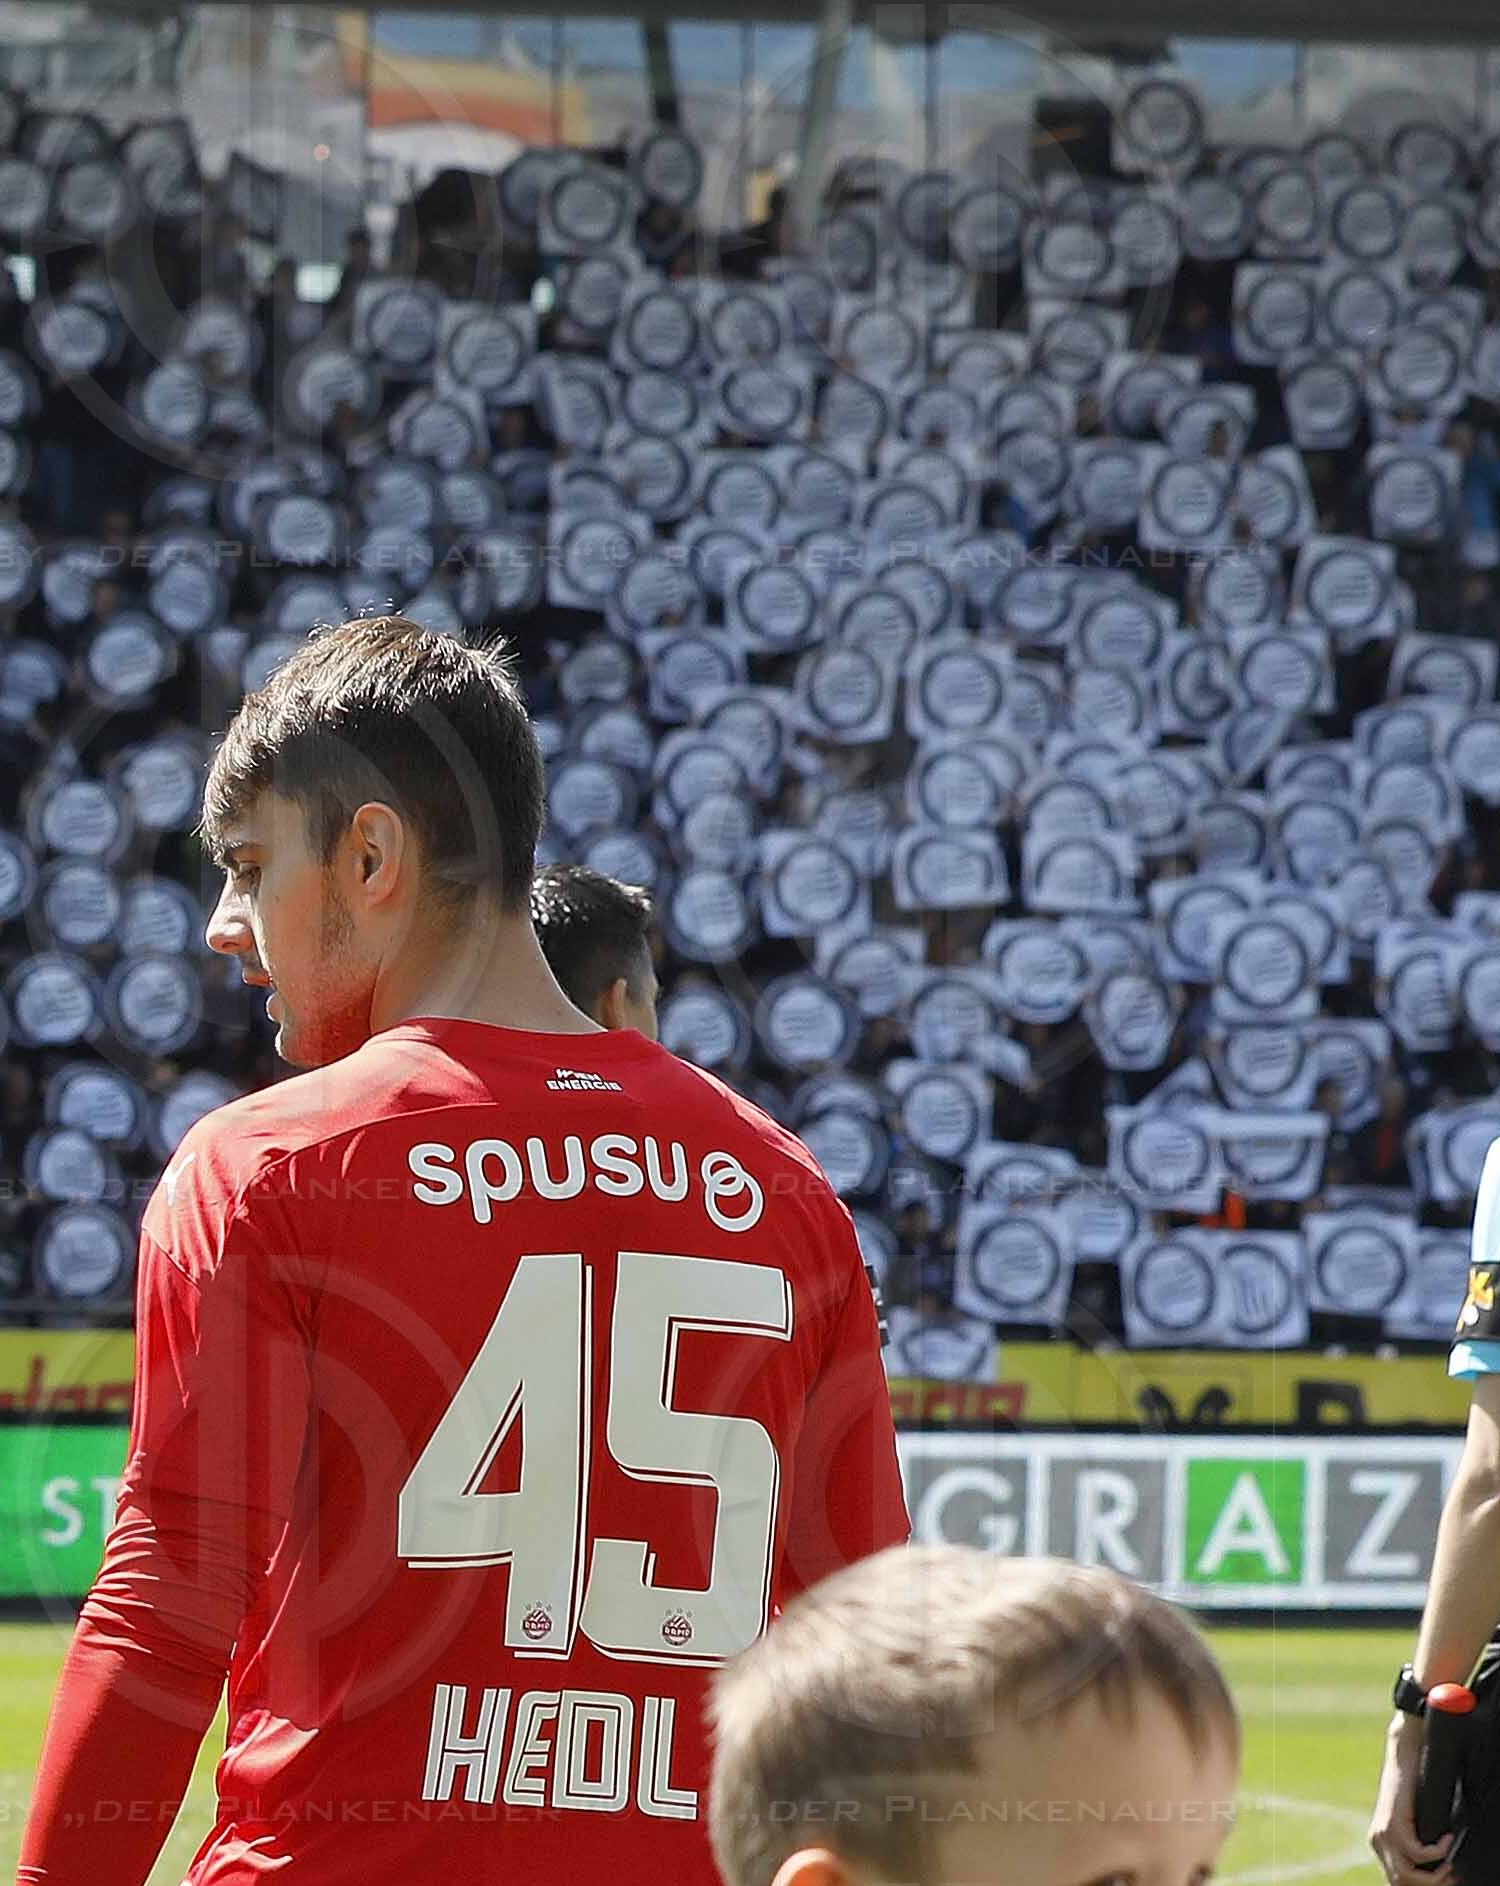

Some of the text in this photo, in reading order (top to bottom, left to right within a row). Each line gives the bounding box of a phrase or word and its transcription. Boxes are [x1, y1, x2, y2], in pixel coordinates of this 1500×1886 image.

[547, 1080, 622, 1090] ENERGIE
[408, 1133, 690, 1224] spusu
[396, 1251, 795, 1669] 45
[40, 1475, 118, 1547] ST
[912, 1466, 1422, 1578] GRAZ
[422, 1683, 699, 1820] HEDL
